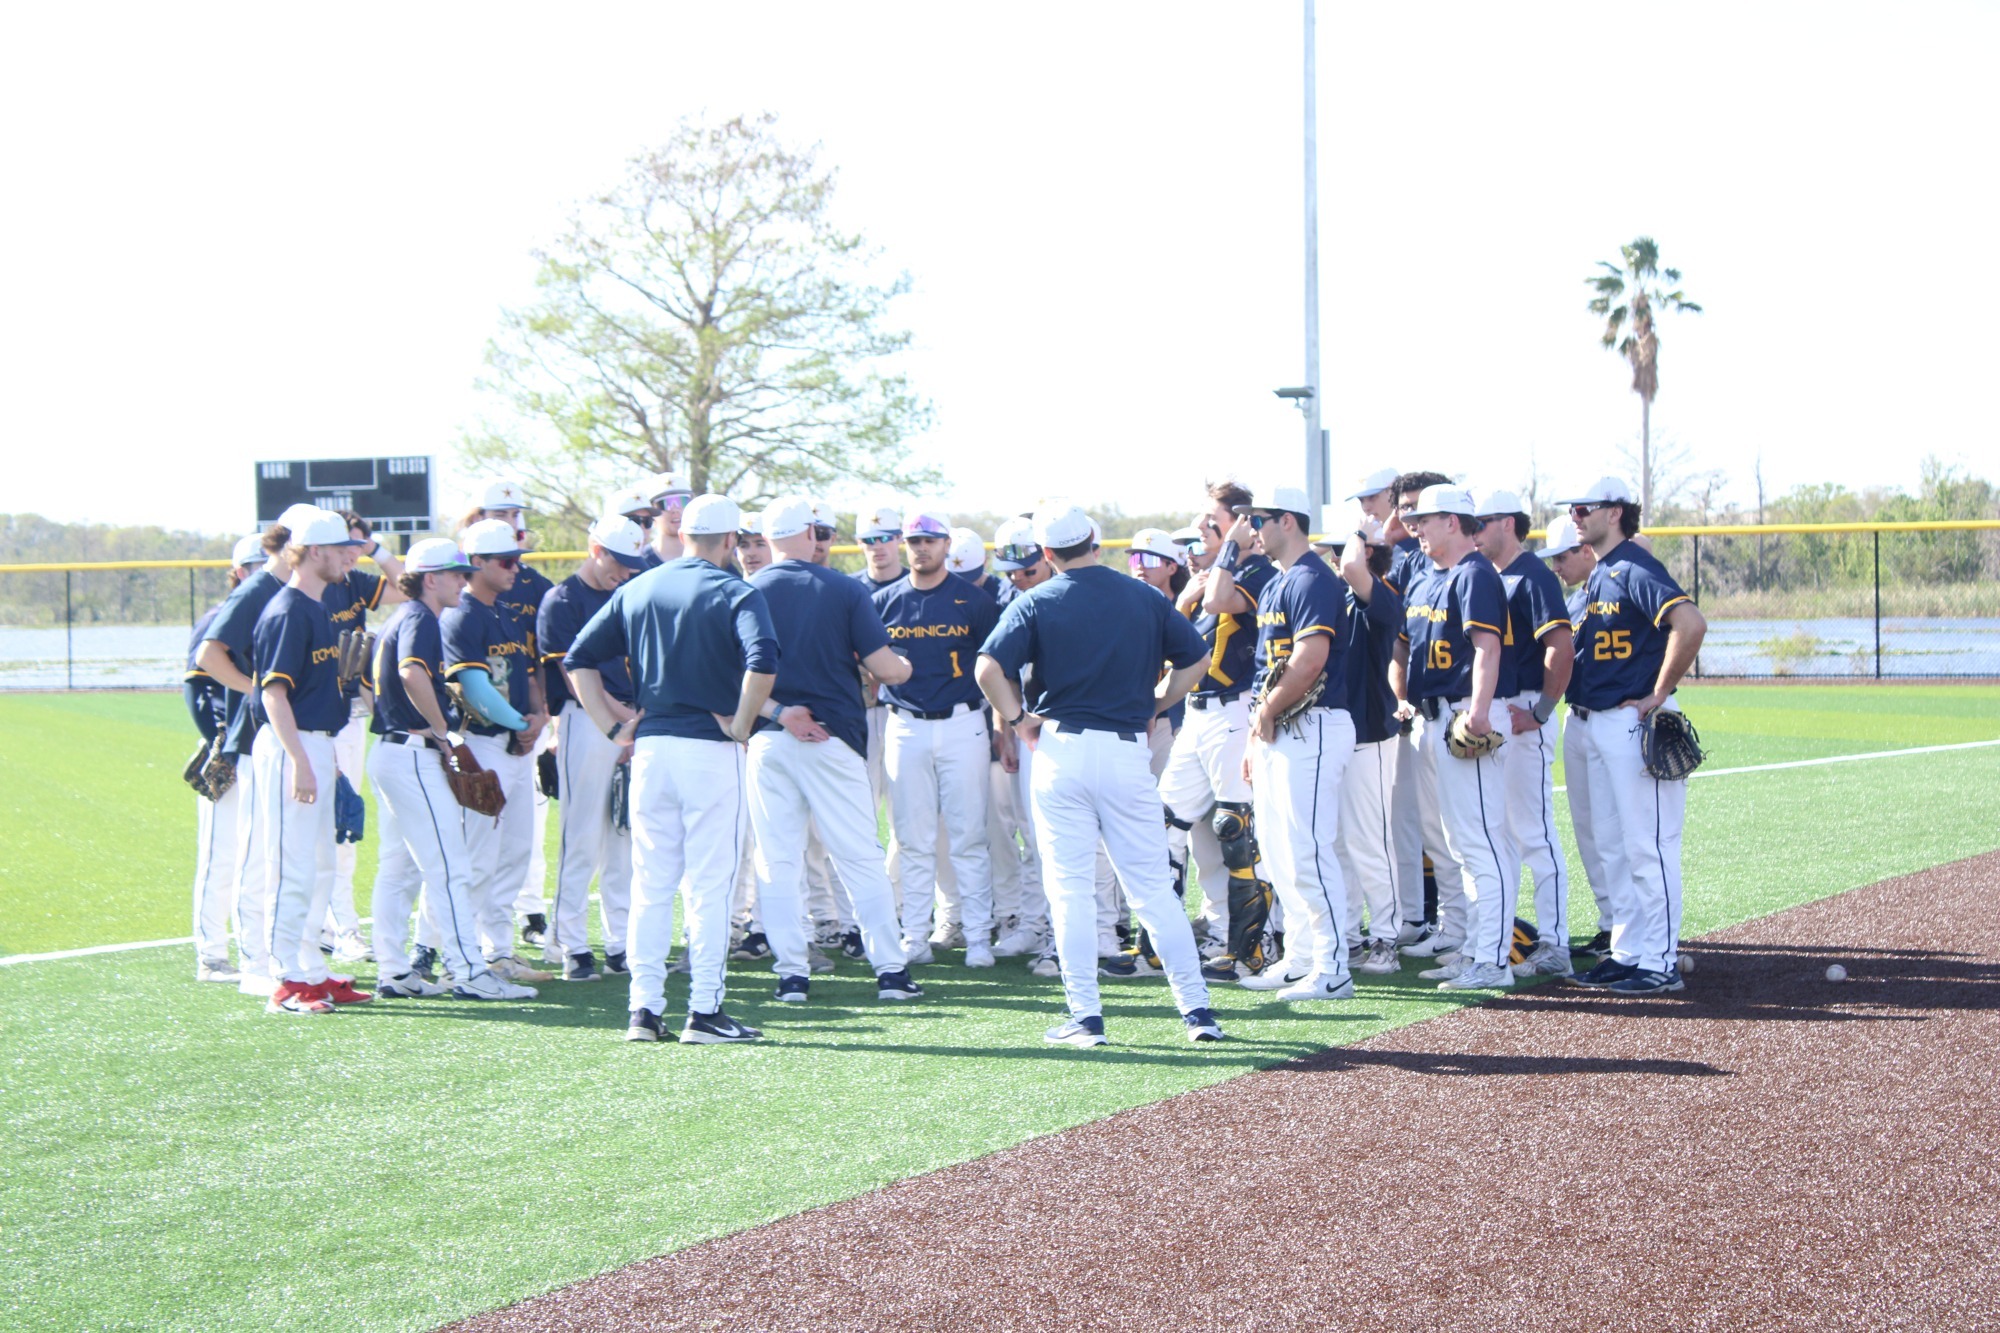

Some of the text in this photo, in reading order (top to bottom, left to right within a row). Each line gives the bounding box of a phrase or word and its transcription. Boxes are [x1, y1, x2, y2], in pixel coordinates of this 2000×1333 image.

[886, 624, 970, 639] DOMINICAN
[1594, 630, 1632, 660] 25
[949, 650, 963, 678] 1
[1426, 639, 1452, 669] 16
